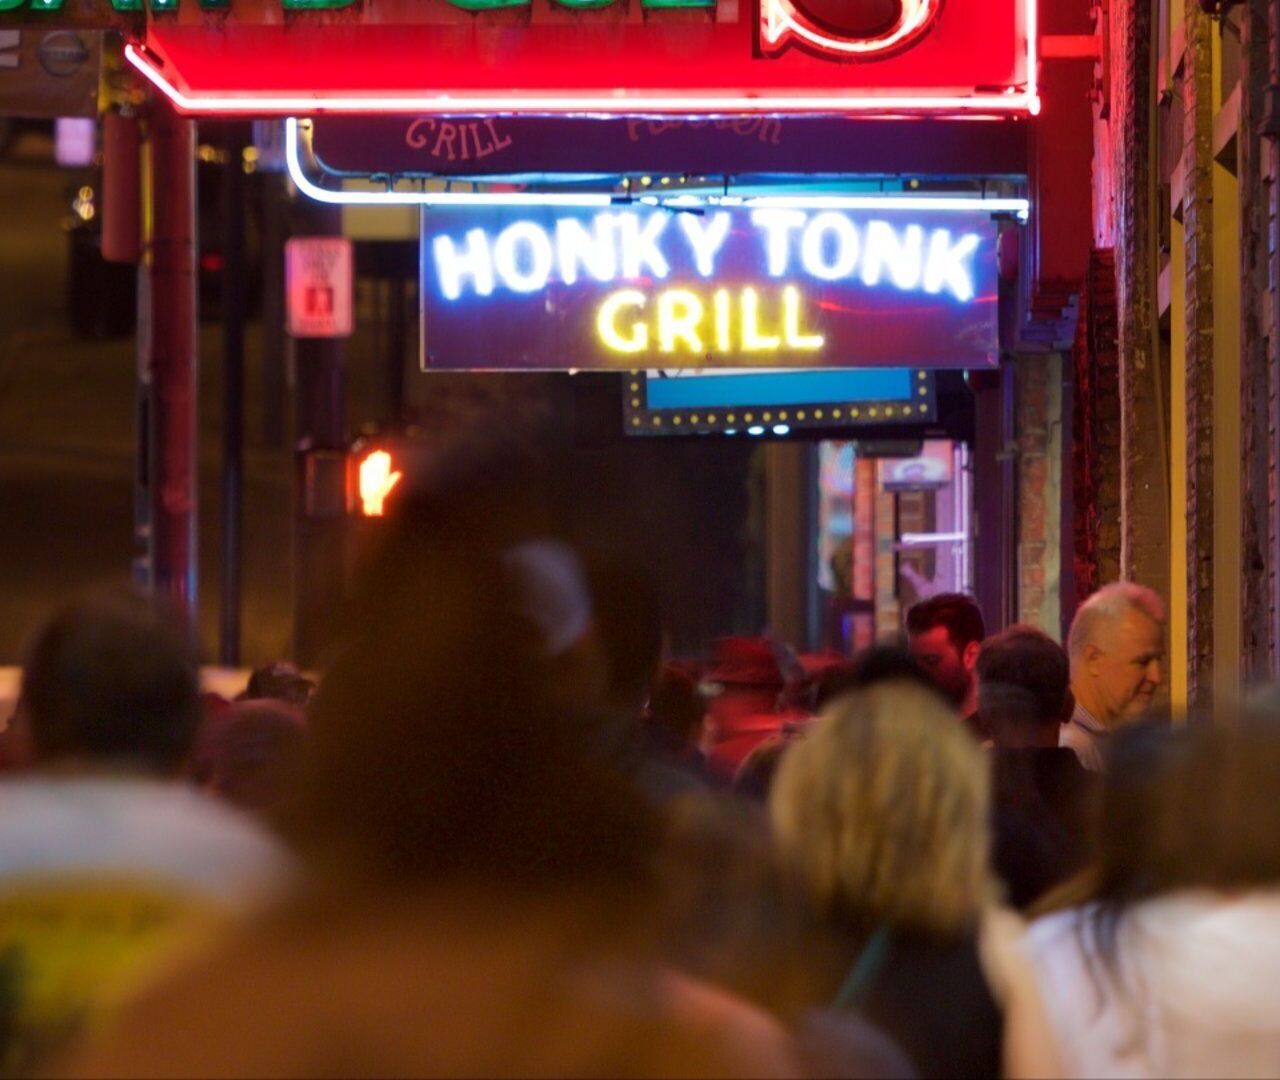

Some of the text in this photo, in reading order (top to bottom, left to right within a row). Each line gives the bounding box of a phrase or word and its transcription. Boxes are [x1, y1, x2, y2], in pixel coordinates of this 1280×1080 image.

[405, 117, 513, 160] GRILL
[431, 210, 731, 302] HONKY
[750, 209, 980, 303] TONK
[596, 285, 826, 355] GRILL
